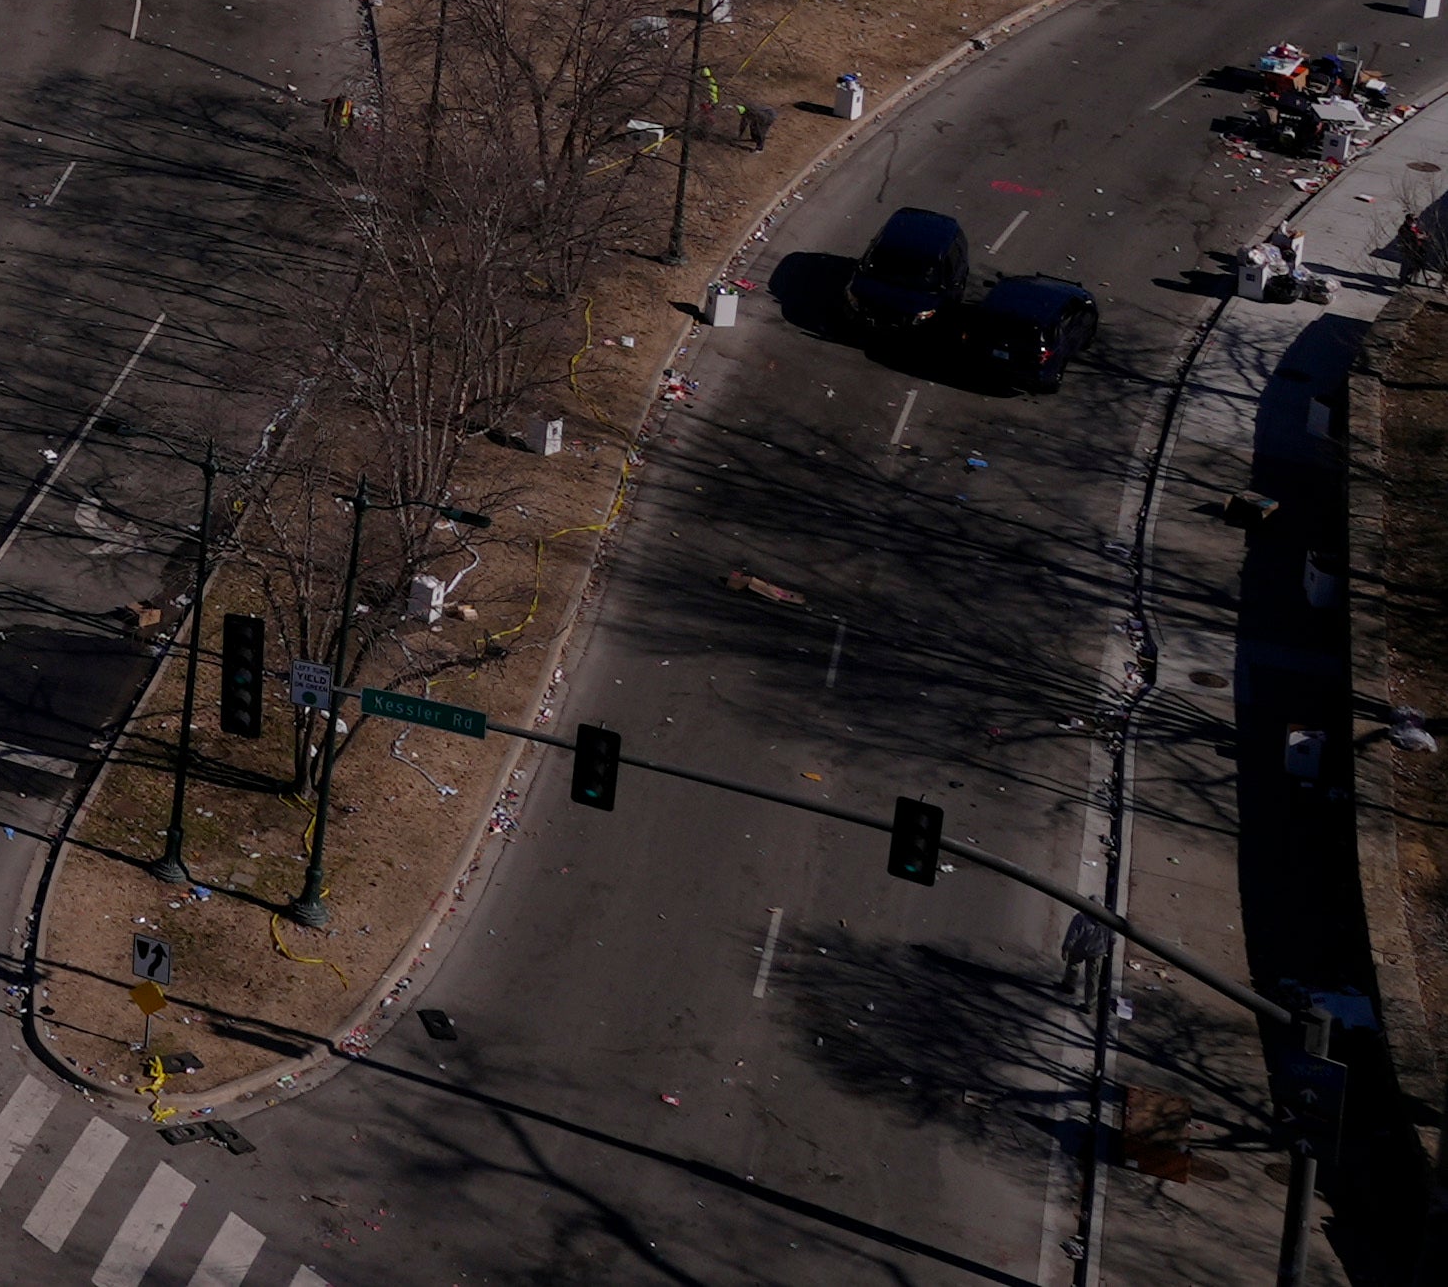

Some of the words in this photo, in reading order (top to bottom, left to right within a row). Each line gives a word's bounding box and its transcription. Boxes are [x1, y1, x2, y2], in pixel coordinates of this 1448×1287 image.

[297, 672, 327, 685] YIELD
[373, 695, 441, 721] Kessler
[453, 713, 474, 731] Rd
